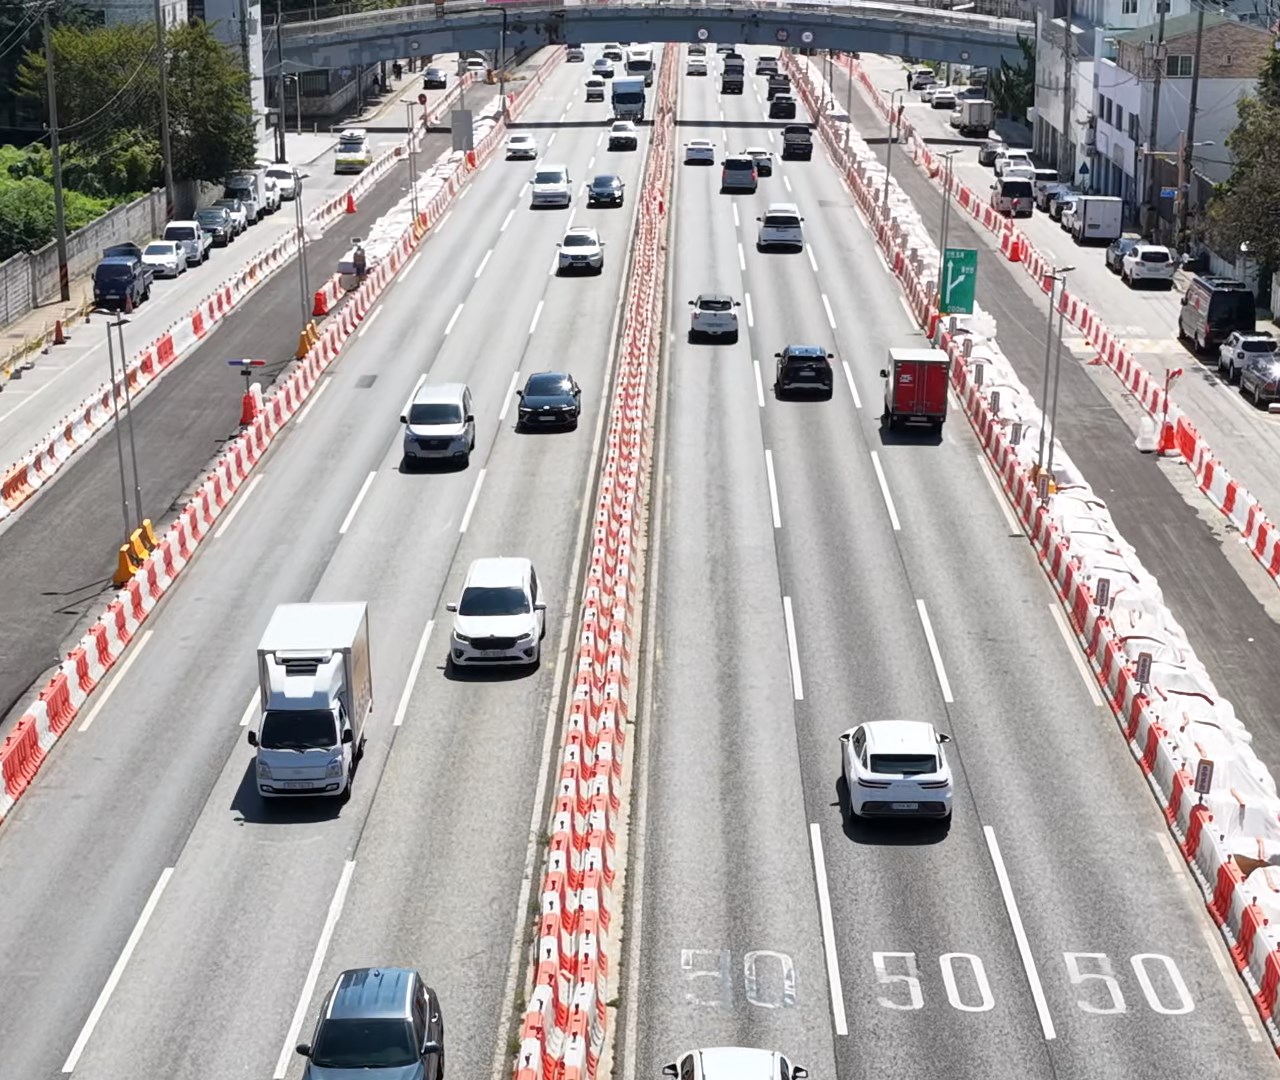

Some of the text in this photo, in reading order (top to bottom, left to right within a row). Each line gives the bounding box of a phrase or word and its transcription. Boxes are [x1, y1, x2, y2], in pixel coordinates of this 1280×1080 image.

[681, 948, 797, 1010] 50
[872, 951, 996, 1013] 50
[1063, 952, 1196, 1015] 50
